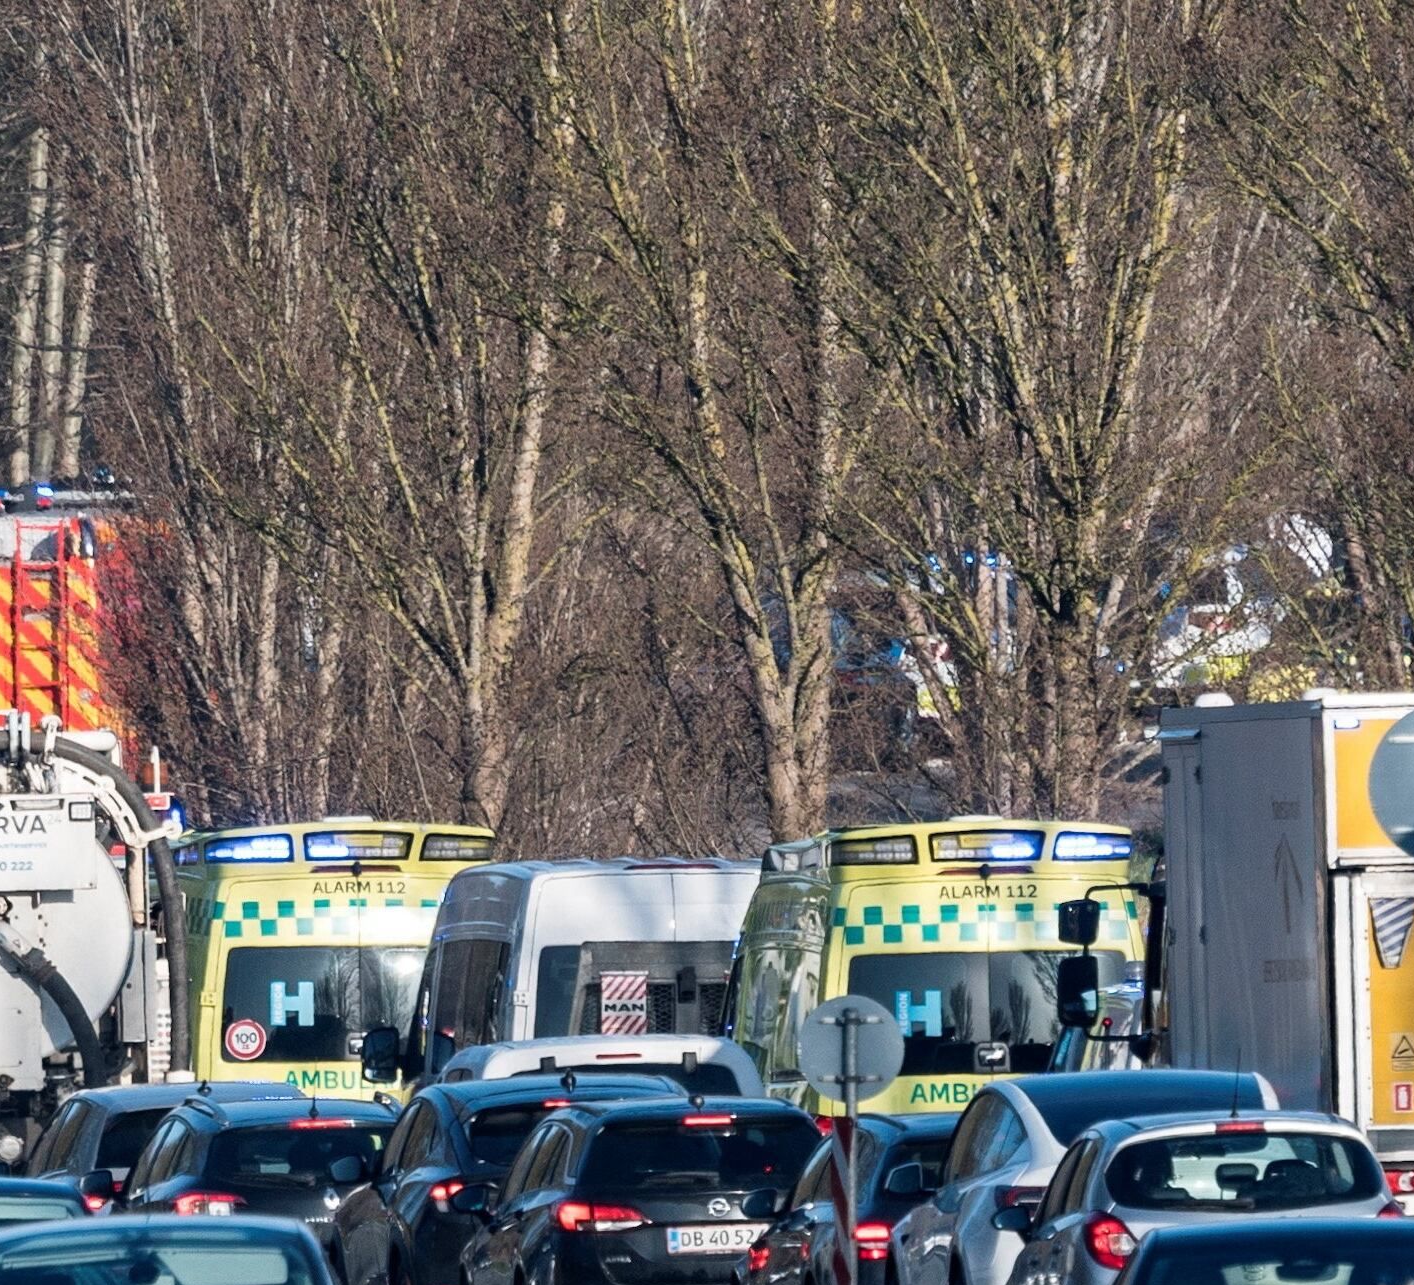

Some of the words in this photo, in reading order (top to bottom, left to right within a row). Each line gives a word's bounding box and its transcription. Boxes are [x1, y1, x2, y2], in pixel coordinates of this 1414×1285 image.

[11, 860, 34, 872] 222
[312, 881, 372, 895] ALARM
[377, 880, 407, 895] 112
[939, 885, 1001, 900] ALARM
[1006, 884, 1039, 899] 112
[603, 1003, 645, 1013] MAN
[234, 1031, 258, 1044] 100
[680, 1231, 704, 1247] DB
[709, 1230, 730, 1246] 40
